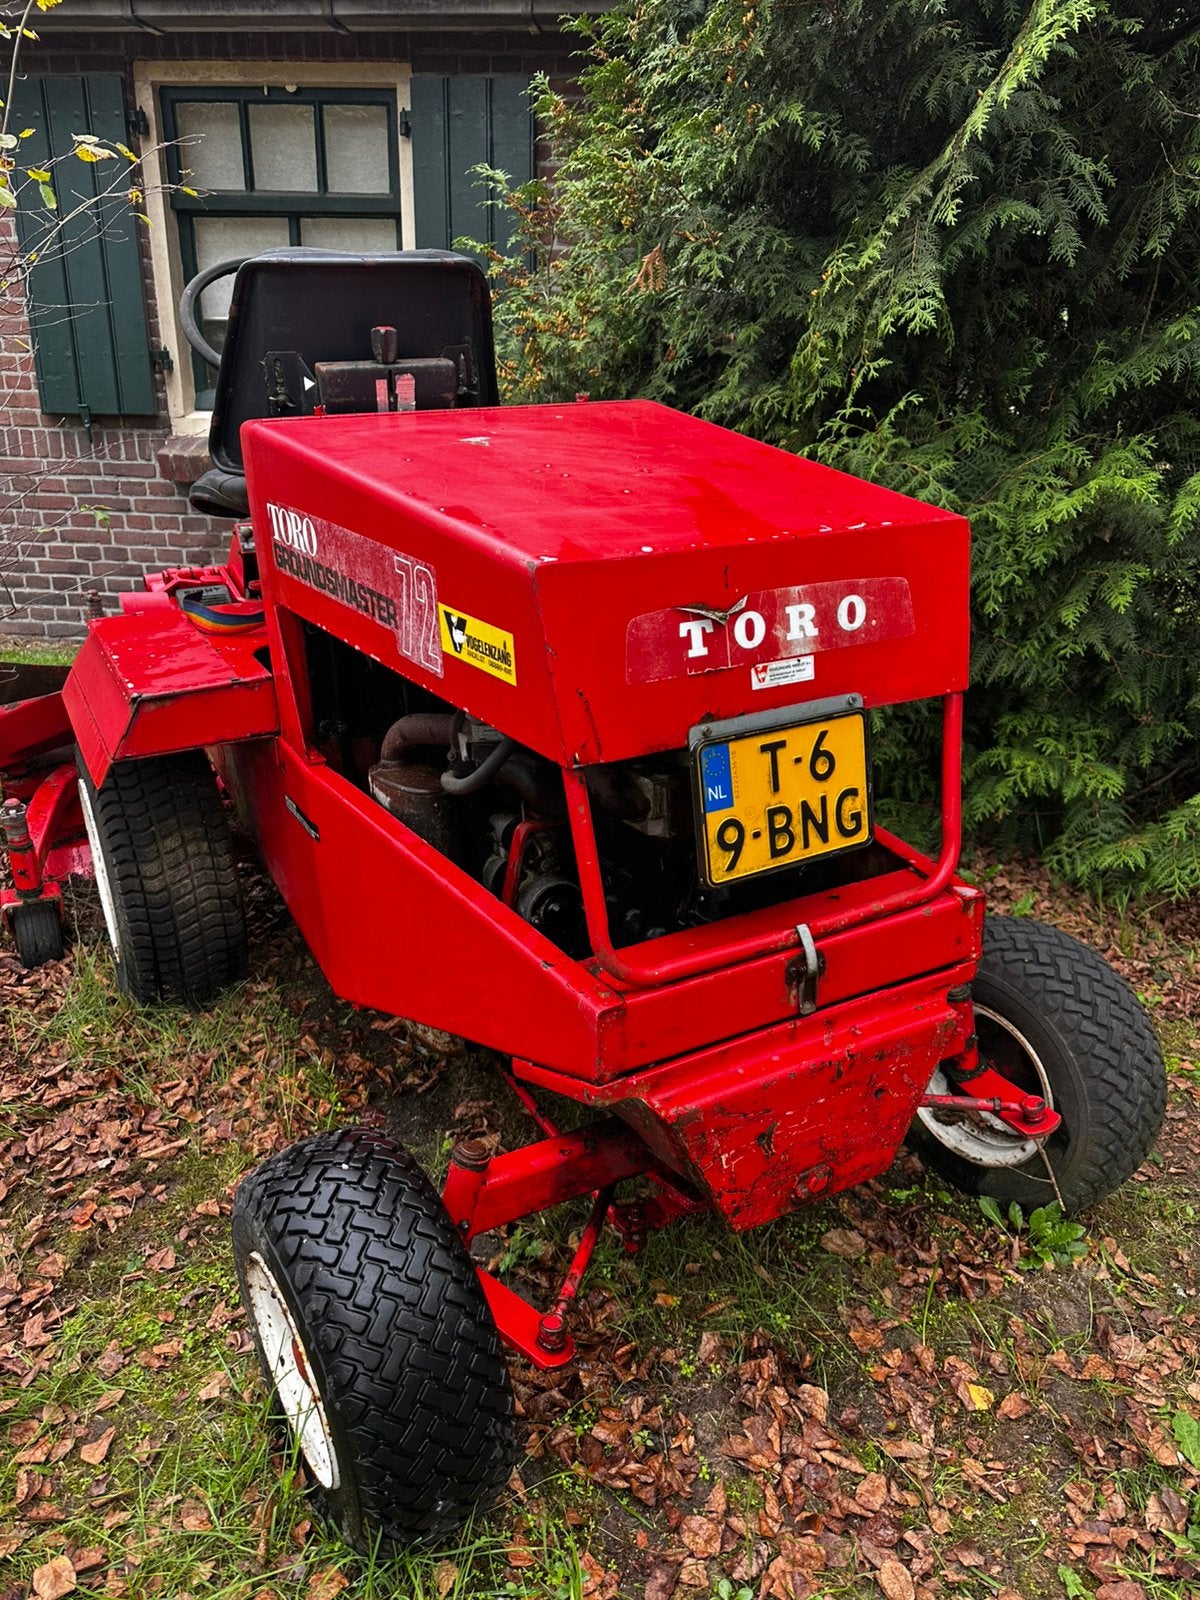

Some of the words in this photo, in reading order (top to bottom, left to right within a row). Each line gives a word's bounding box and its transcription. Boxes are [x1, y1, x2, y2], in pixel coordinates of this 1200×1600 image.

[266, 502, 318, 557] TORO
[273, 543, 399, 630] GROUNDSMASTER
[393, 555, 441, 674] 72
[679, 594, 867, 659] TORO
[465, 633, 512, 668] VOGELENZANG
[707, 784, 728, 802] NL
[759, 729, 836, 793] T-6
[715, 786, 863, 873] 9-BNG
